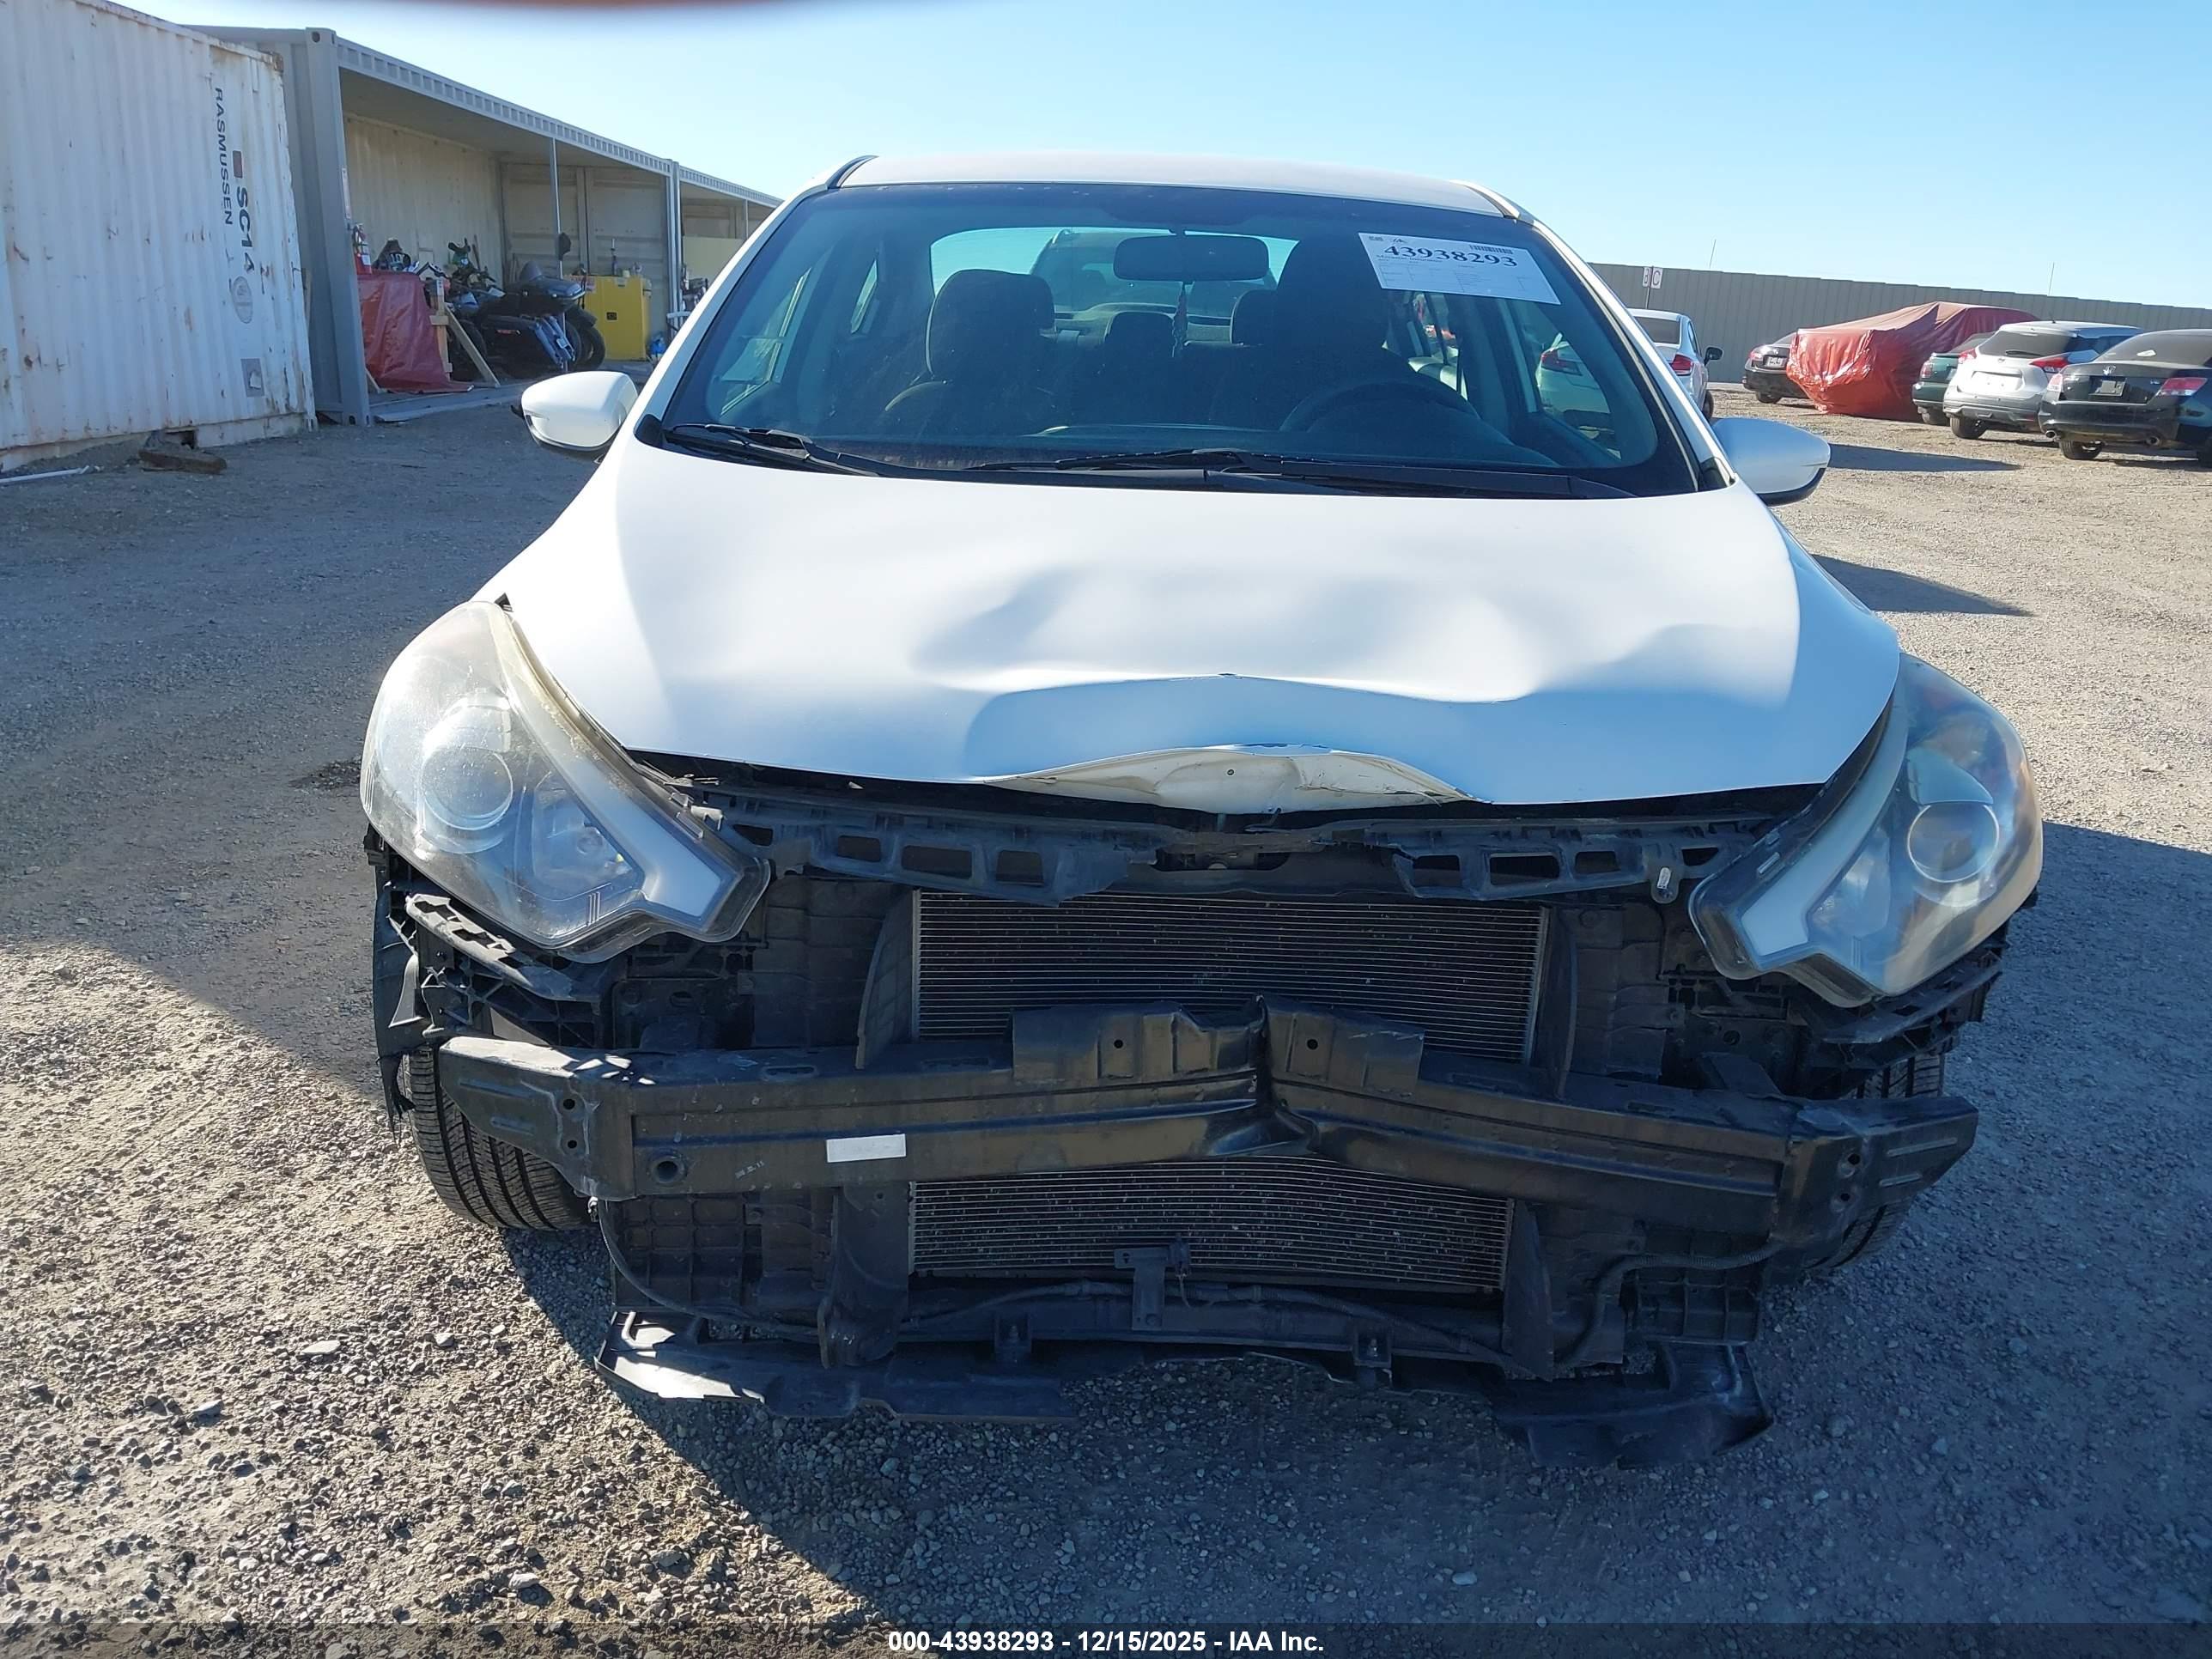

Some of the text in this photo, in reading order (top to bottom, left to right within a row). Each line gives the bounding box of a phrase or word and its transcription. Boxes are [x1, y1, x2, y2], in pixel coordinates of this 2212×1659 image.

[215, 87, 233, 225] RASMUSSEN
[1384, 246, 1517, 267] 43938293
[1652, 270, 1661, 285] C
